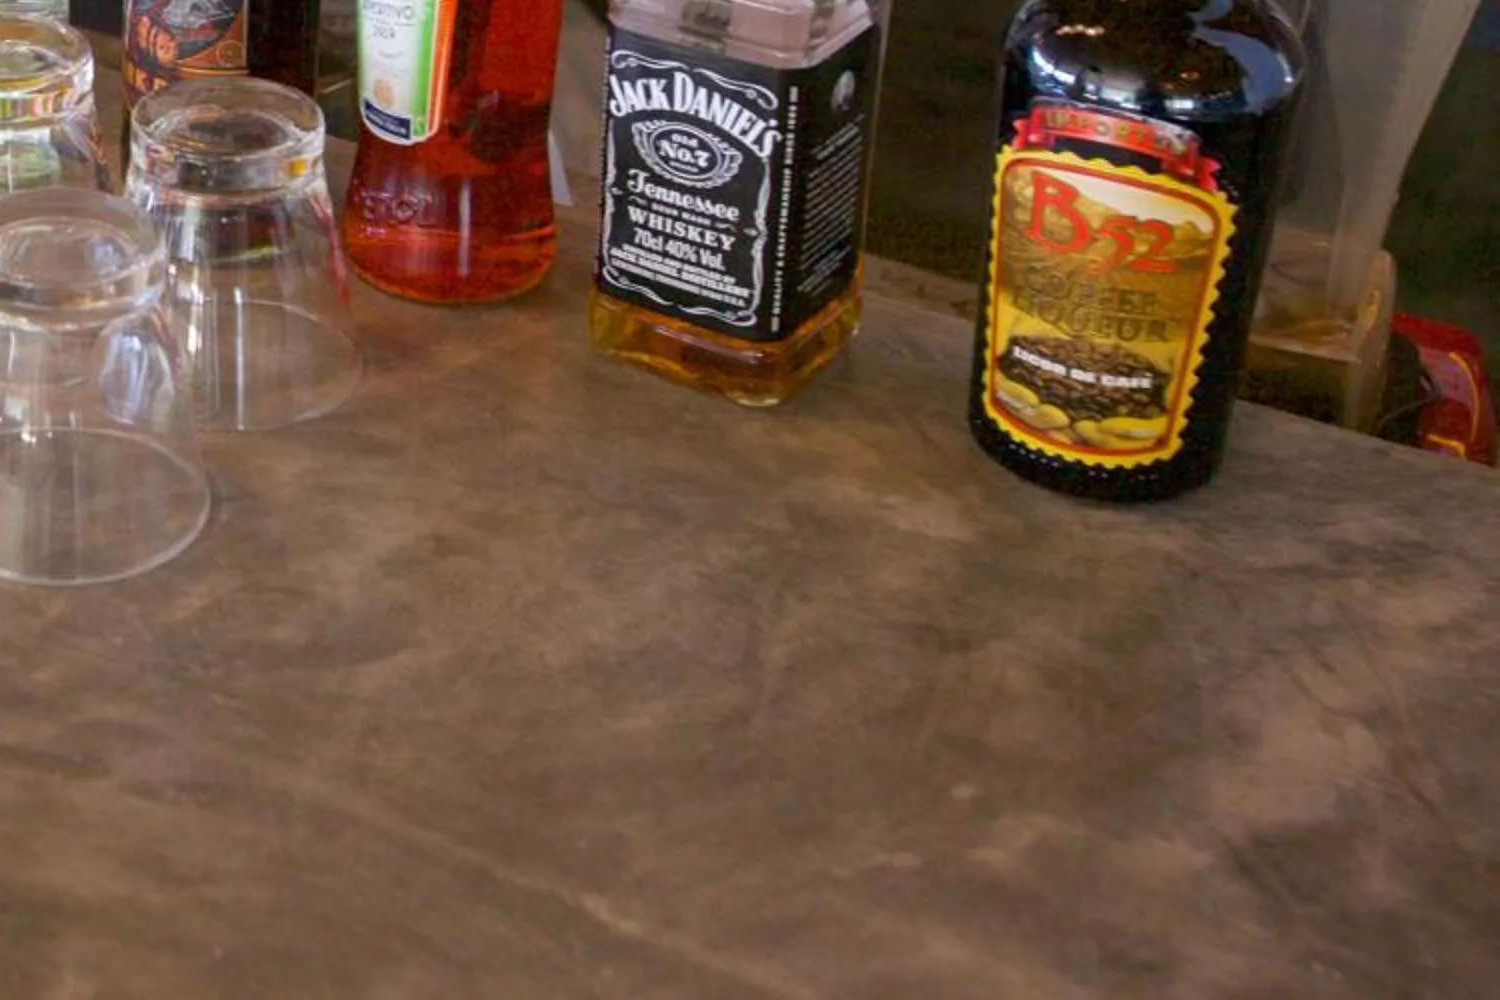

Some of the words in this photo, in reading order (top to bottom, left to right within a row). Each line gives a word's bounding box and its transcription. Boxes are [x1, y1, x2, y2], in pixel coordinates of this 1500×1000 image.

[609, 73, 671, 117] JACK
[673, 71, 783, 157] DANIEL'S
[628, 169, 739, 221] Tennessee
[628, 205, 736, 250] WHISKEY
[633, 227, 663, 251] 70cl
[666, 239, 698, 263] 40%
